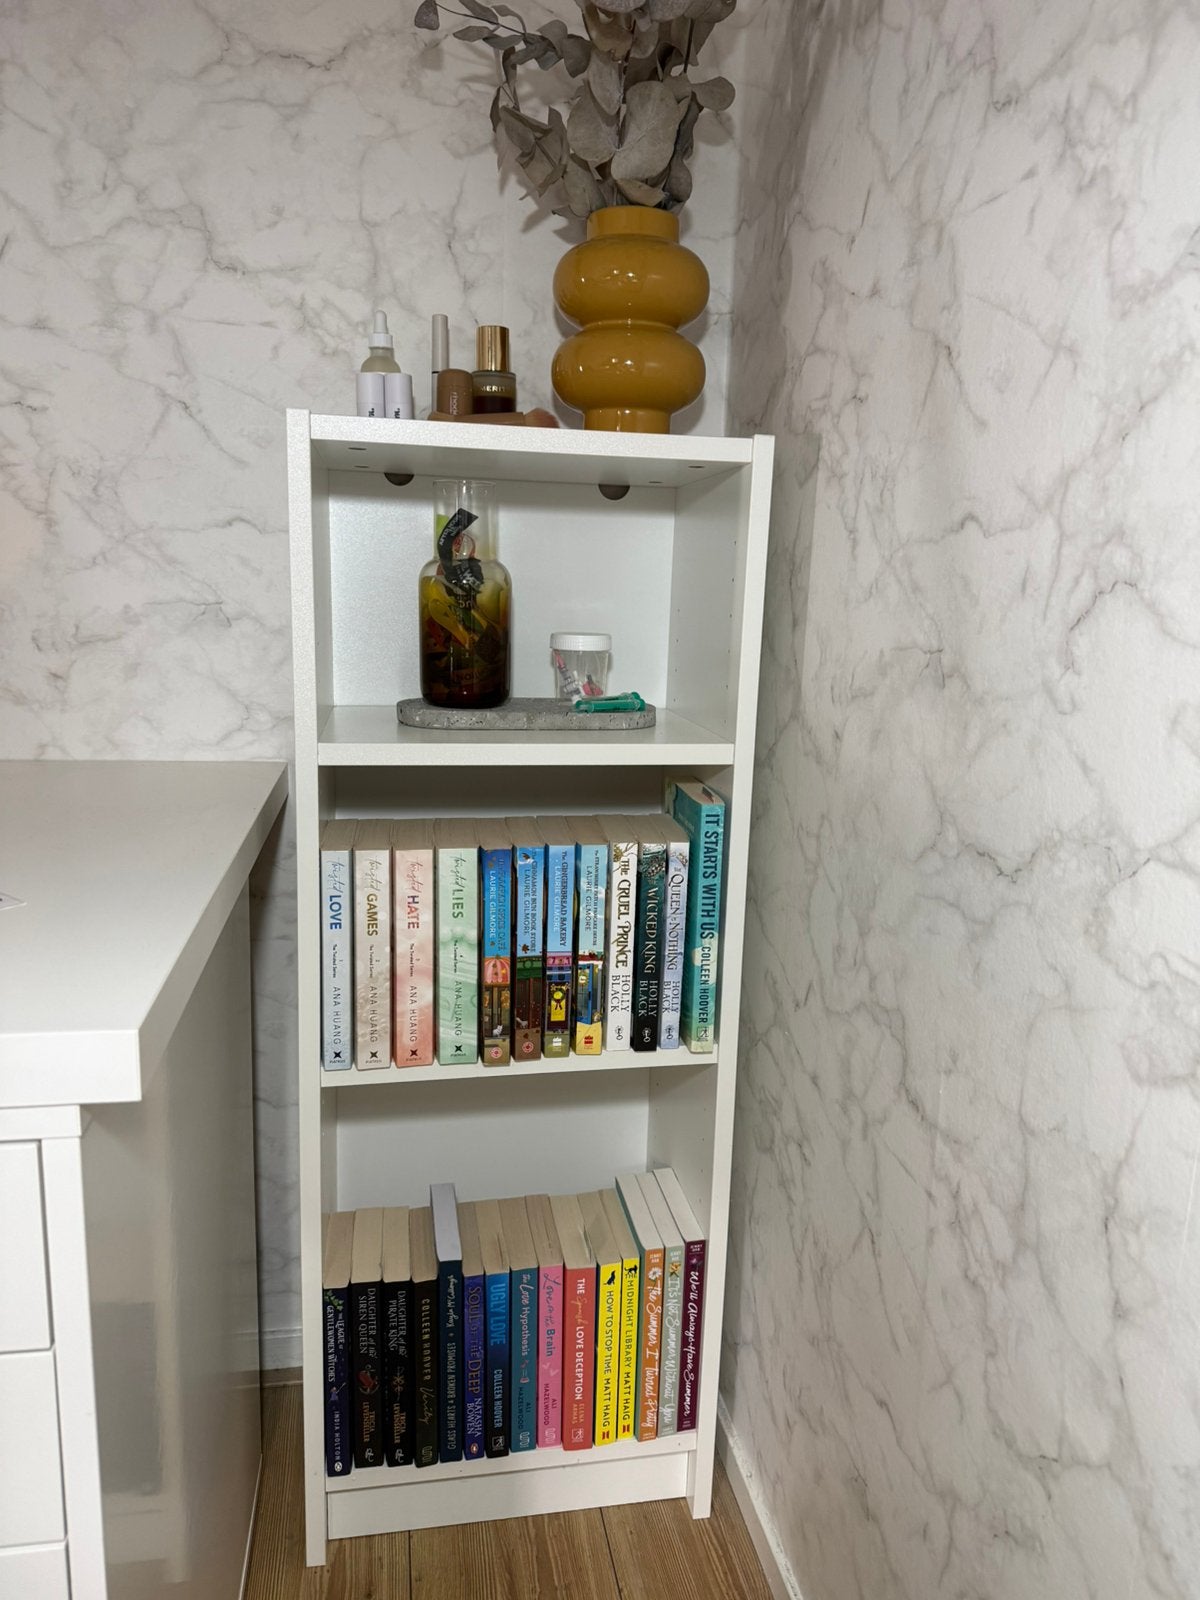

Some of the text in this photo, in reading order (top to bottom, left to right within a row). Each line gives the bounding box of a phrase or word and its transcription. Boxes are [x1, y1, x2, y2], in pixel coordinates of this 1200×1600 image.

[327, 856, 345, 930] twisted LOVE
[669, 874, 684, 915] QUEEN
[700, 814, 720, 939] IT STARTS WITH US
[366, 893, 378, 937] GAMES
[407, 895, 419, 930] HATE
[452, 889, 464, 919] LIES
[616, 879, 632, 920] CRUEL
[645, 887, 659, 938] WICKED
[612, 920, 632, 968] PRINCE
[641, 941, 656, 973] KING
[667, 921, 683, 970] NOTHING
[700, 946, 711, 985] COLLEEN
[611, 975, 620, 1013] BLACK
[621, 975, 630, 1012] HOLLY
[638, 980, 648, 1017] BLACK
[648, 980, 658, 1017] HOLLY
[662, 981, 671, 1014] BLACK
[671, 981, 680, 1013] HOLLY
[698, 988, 709, 1023] HOOVER
[333, 987, 341, 1045] ANA HUANG
[370, 986, 378, 1043] ANA HUANG
[409, 985, 418, 1042] ANA HUANG
[454, 1004, 462, 1036] HUANG
[468, 1286, 482, 1322] SOUL
[519, 1284, 534, 1305] Love
[543, 1273, 561, 1304] Love
[576, 1278, 585, 1294] THE
[625, 1280, 634, 1327] MIDNIGHT
[647, 1280, 662, 1302] The
[689, 1271, 700, 1300] We'll
[358, 1295, 367, 1354] SIREN QUEEN
[368, 1288, 376, 1335] DAUGHTER
[388, 1300, 397, 1351] PIRATE KING
[397, 1291, 406, 1337] DAUGHTER
[490, 1283, 506, 1346] UGLY LOVE
[646, 1302, 662, 1346] Summer
[666, 1299, 680, 1315] Not
[685, 1302, 698, 1342] Always
[336, 1320, 345, 1343] LEAGUE
[470, 1339, 480, 1357] THE
[520, 1307, 530, 1356] Hypothesis
[546, 1328, 556, 1357] Brain
[576, 1326, 584, 1349] LOVE
[604, 1290, 614, 1375] HOW TO STOP TIME
[624, 1330, 632, 1368] LIBRARY
[665, 1316, 680, 1359] Summer
[328, 1354, 337, 1382] WITCHES
[418, 1298, 435, 1425] COLLEEN HOOVER Verity
[447, 1342, 456, 1373] PROMISES
[646, 1347, 659, 1360] I
[683, 1343, 696, 1371] Have
[447, 1374, 456, 1398] BROKEN
[468, 1359, 482, 1394] DEEP
[494, 1369, 502, 1399] COLLEEN
[575, 1352, 583, 1400] DECEPTION
[645, 1361, 659, 1398] Turned
[664, 1360, 676, 1404] Without
[683, 1370, 694, 1416] Summer
[494, 1400, 502, 1428] HOOVER
[602, 1378, 611, 1427] MATT HAIG
[622, 1372, 631, 1421] MATT HAIG
[641, 1398, 659, 1429] Pretty
[659, 1403, 675, 1424] You
[447, 1405, 456, 1428] HEARTS
[466, 1403, 474, 1434] BOWEN
[474, 1397, 482, 1437] NATASHA
[447, 1430, 456, 1450] GLASS
